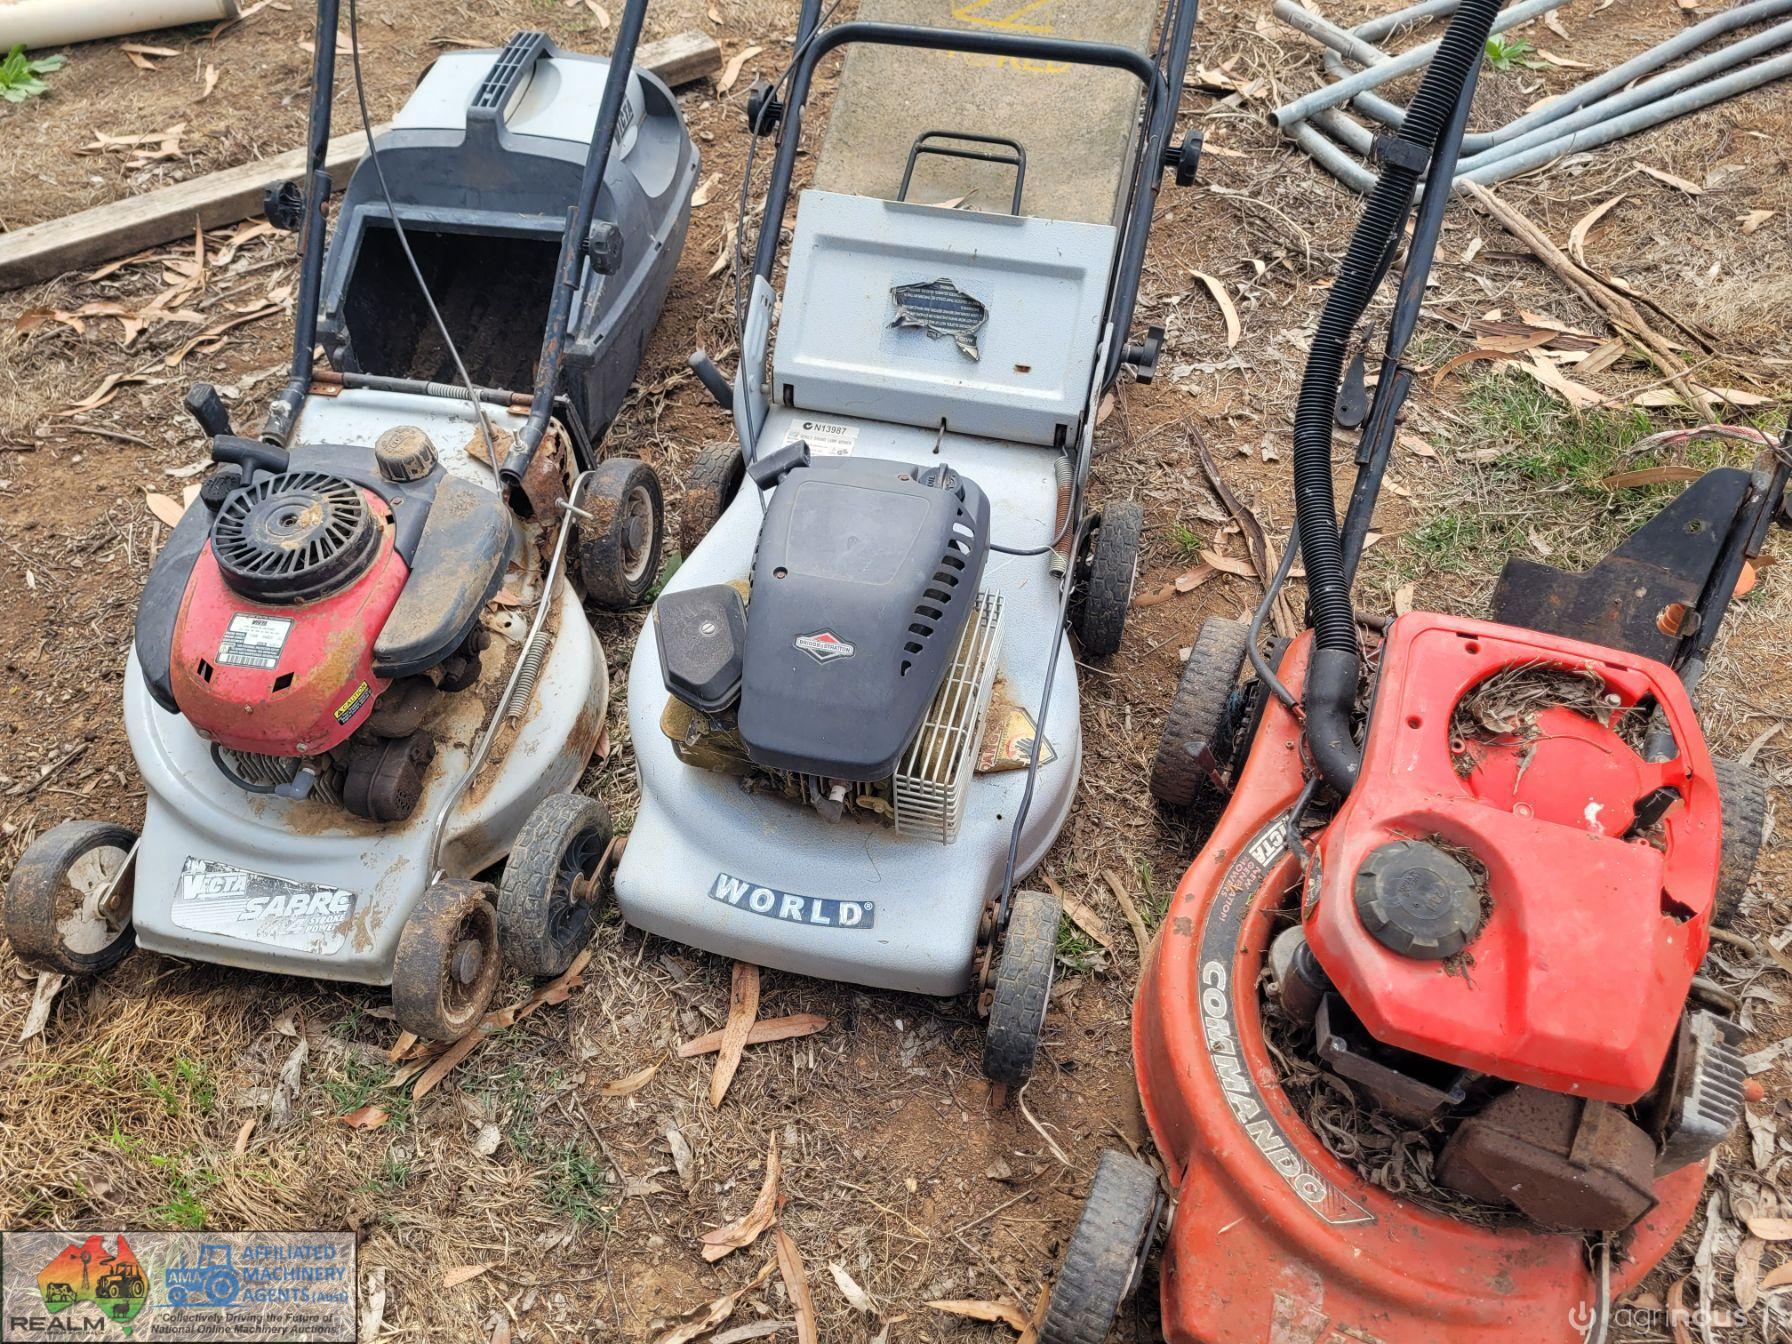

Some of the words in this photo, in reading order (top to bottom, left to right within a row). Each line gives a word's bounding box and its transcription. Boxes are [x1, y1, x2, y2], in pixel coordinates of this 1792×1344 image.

[813, 424, 847, 435] N13987
[342, 683, 367, 710] CAUTION
[1249, 820, 1289, 865] ICTA
[1244, 866, 1262, 890] NEW
[1203, 960, 1328, 1203] COMMANDO
